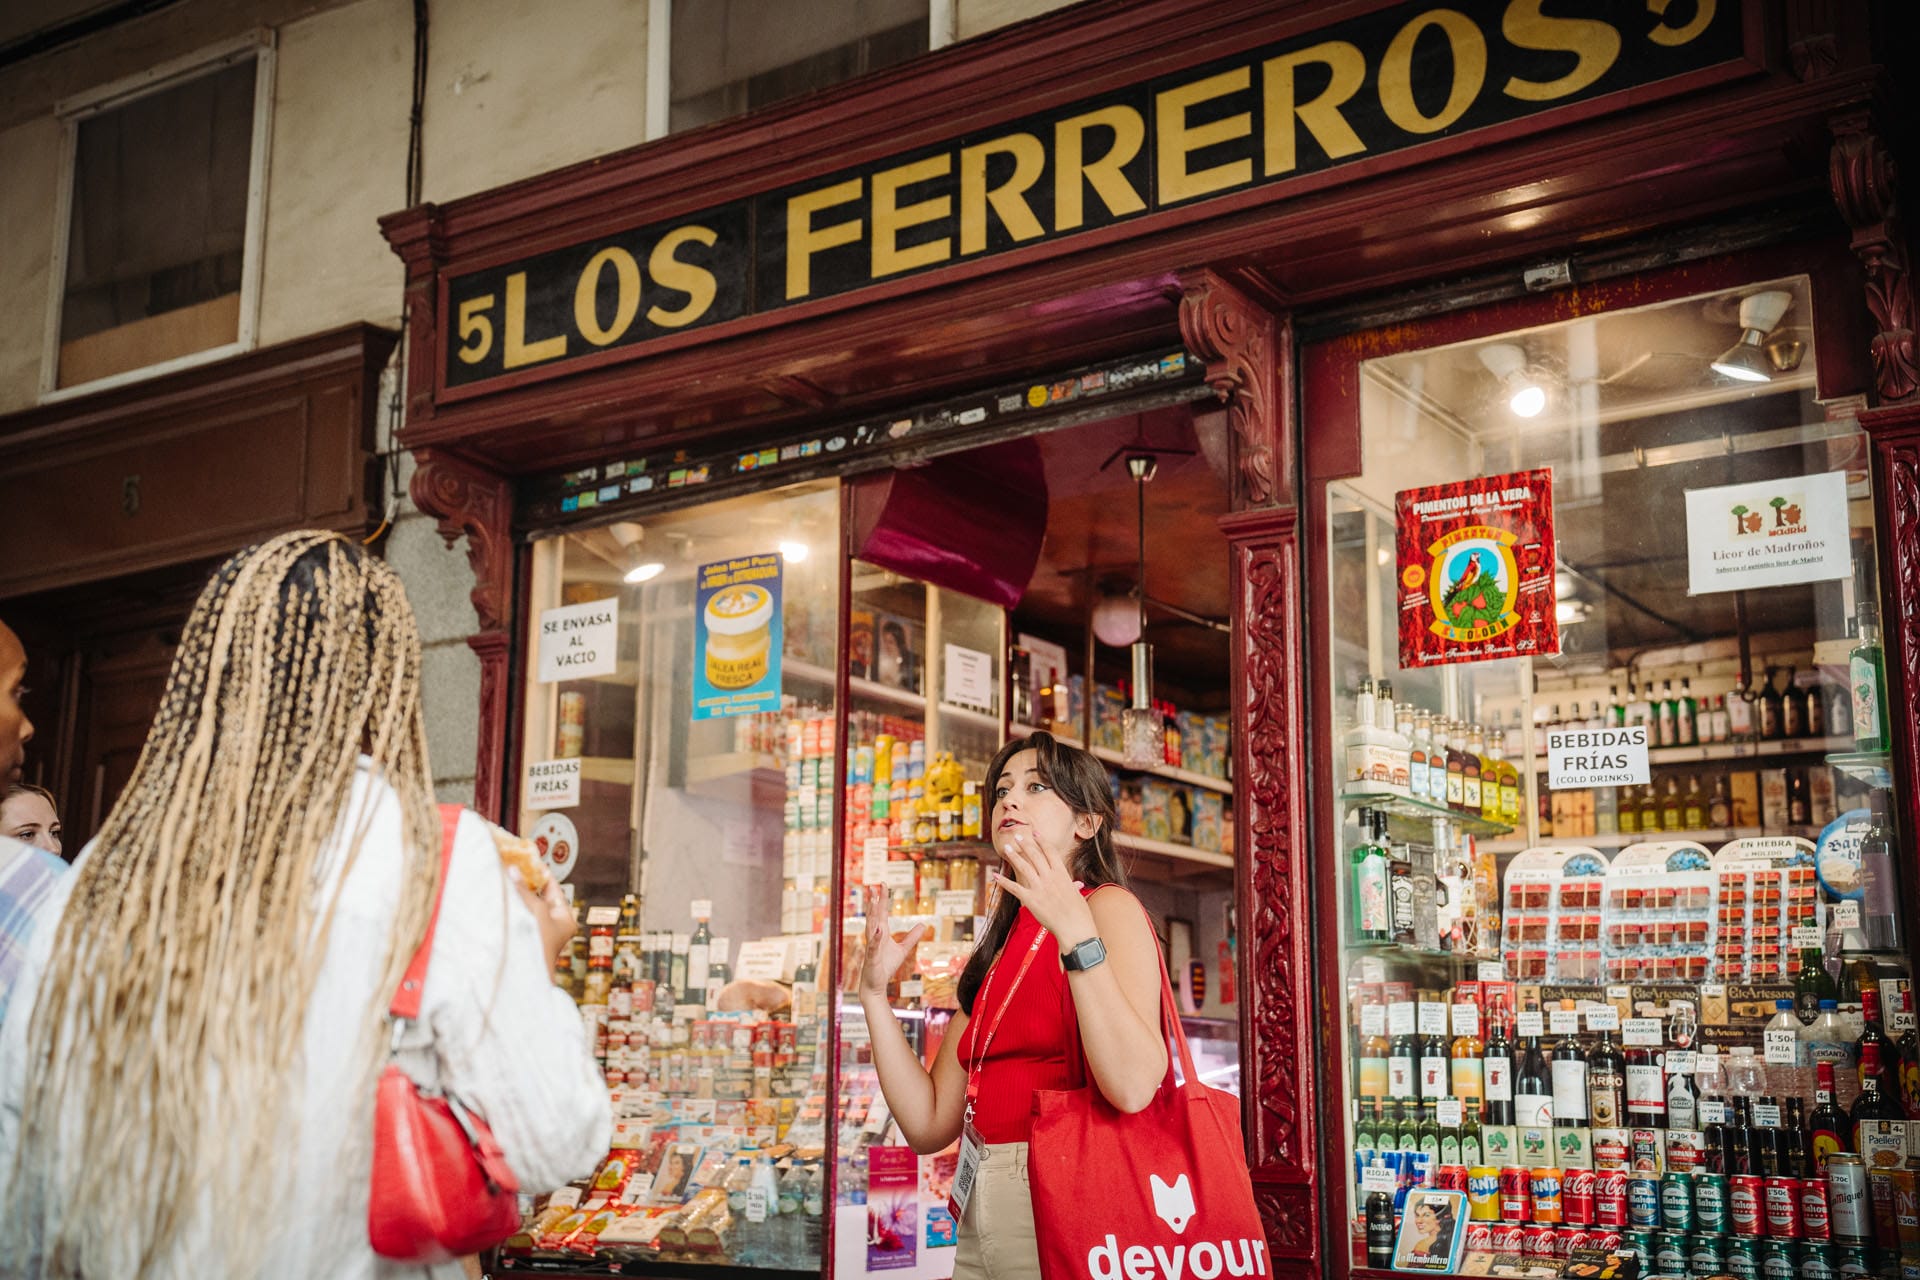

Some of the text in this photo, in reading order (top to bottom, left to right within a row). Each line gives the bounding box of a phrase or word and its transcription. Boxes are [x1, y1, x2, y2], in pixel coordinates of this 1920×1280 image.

[457, 293, 495, 364] 5
[502, 224, 718, 369] LOS
[785, 0, 1622, 300] FERREROS
[122, 473, 141, 517] 5
[1413, 487, 1531, 515] PIMENTON DE LA VERA
[1712, 539, 1826, 561] Licor de Madroños
[1791, 558, 1799, 566] de
[1800, 555, 1824, 565] Madrid
[543, 612, 612, 634] SE ENVASA
[1443, 626, 1456, 638] EL
[569, 635, 584, 648] AL
[1550, 730, 1646, 750] BEBIDAS
[528, 761, 579, 778] BEBIDAS
[1563, 750, 1629, 771] FRÍAS
[1556, 773, 1635, 785] (COLD DRINKS)
[1740, 839, 1793, 849] EN HEBRA
[1868, 1134, 1902, 1146] Paellero
[1366, 1169, 1390, 1177] RIOJA
[1087, 1233, 1267, 1280] devour
